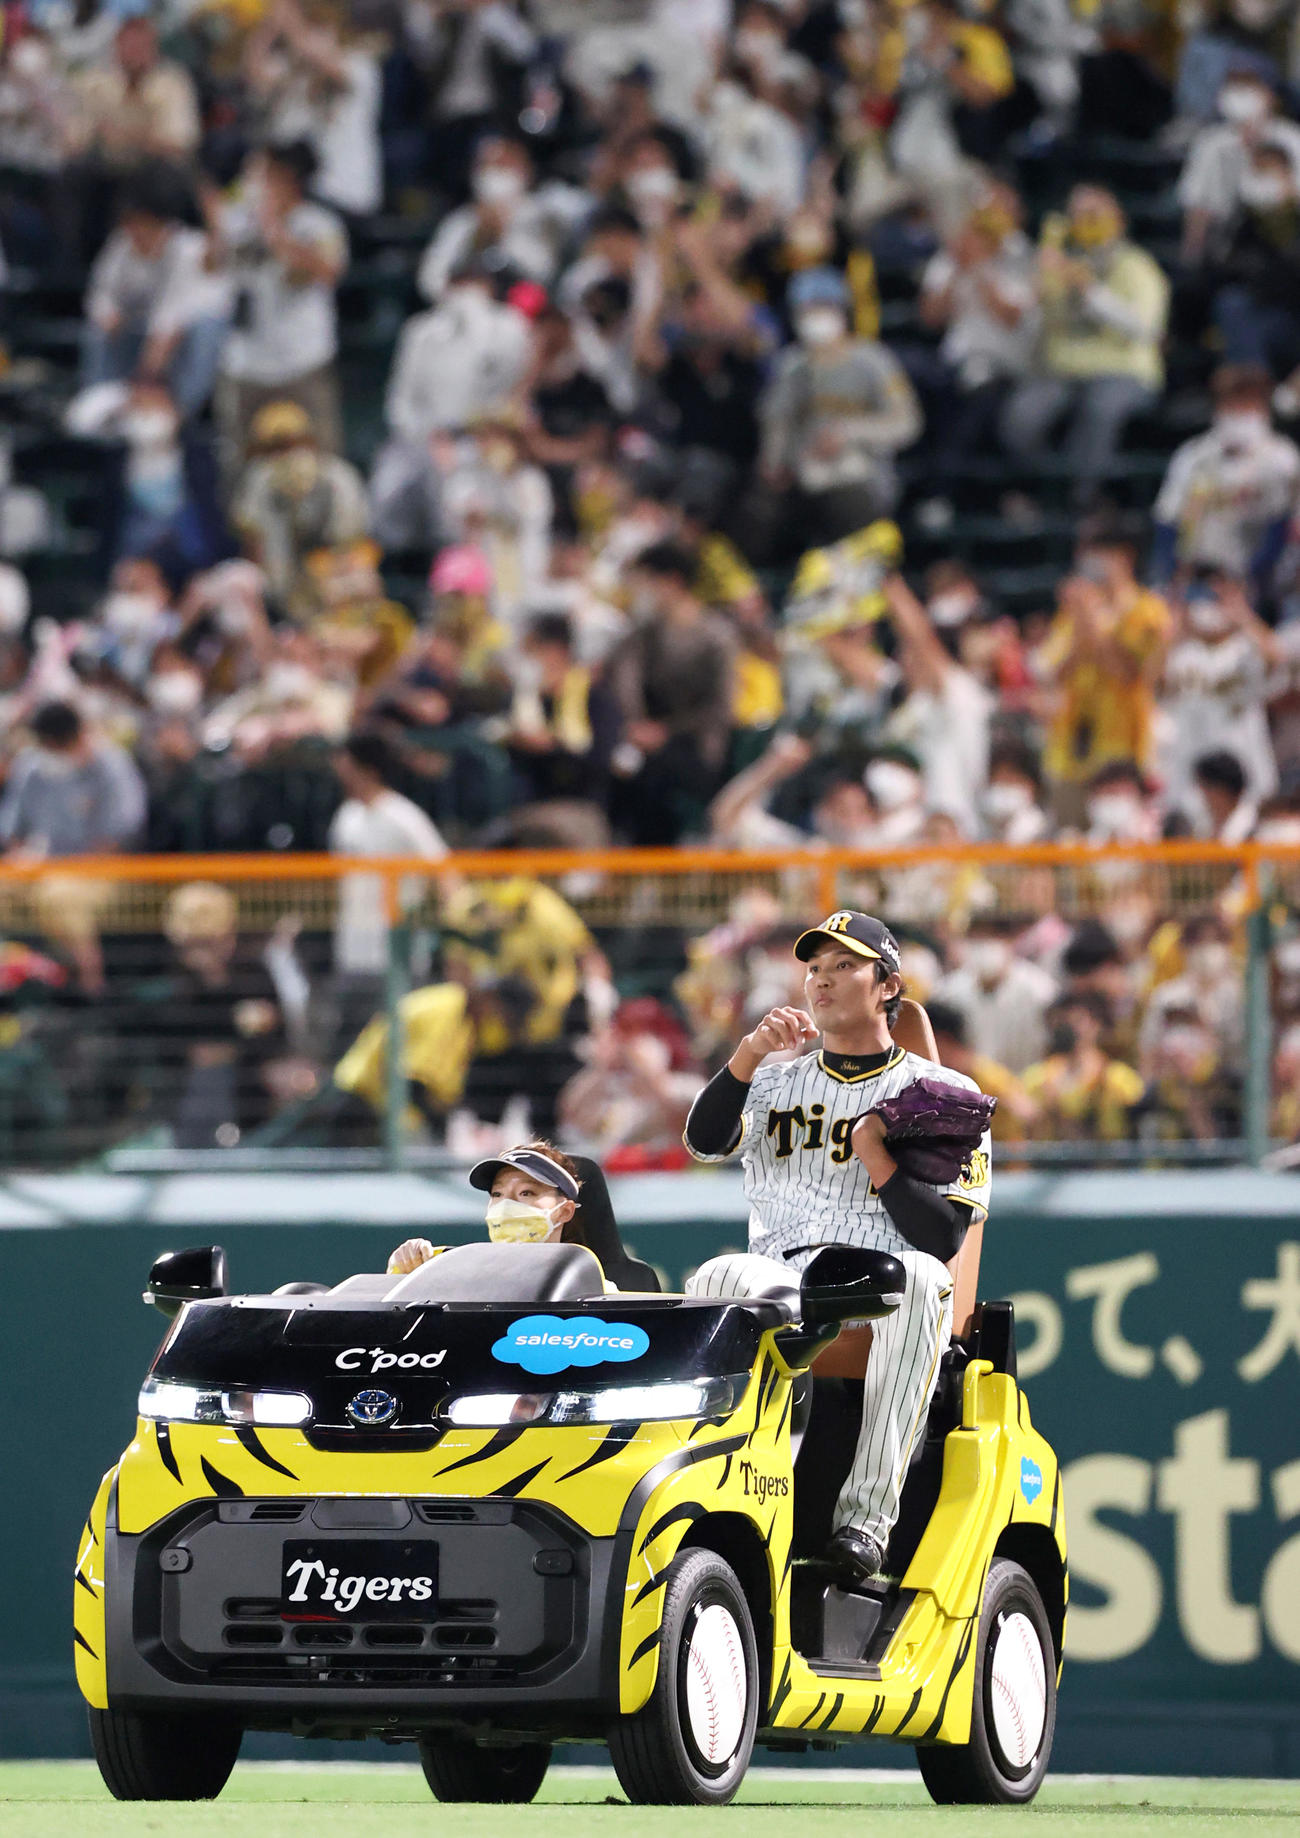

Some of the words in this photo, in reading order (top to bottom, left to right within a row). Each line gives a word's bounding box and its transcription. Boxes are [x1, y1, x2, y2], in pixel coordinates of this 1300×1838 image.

[515, 1332, 635, 1349] salesforce
[740, 1460, 789, 1506] Tigers
[286, 1558, 434, 1613] Tigers
